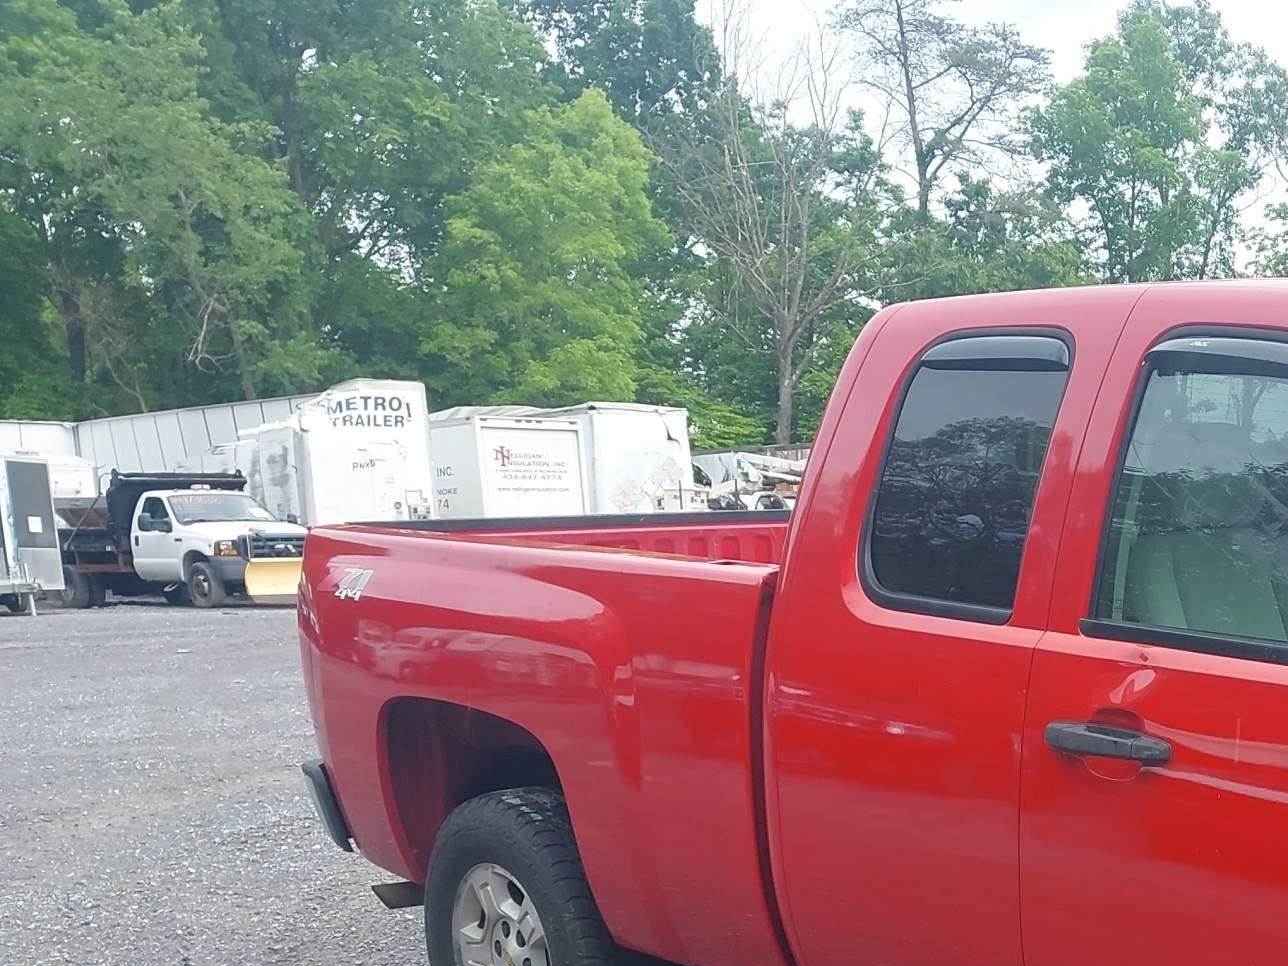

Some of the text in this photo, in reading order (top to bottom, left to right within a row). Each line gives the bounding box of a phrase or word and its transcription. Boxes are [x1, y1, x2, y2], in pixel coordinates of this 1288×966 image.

[327, 396, 402, 415] METRO
[330, 414, 405, 427] TRAILER
[436, 465, 456, 477] INC.
